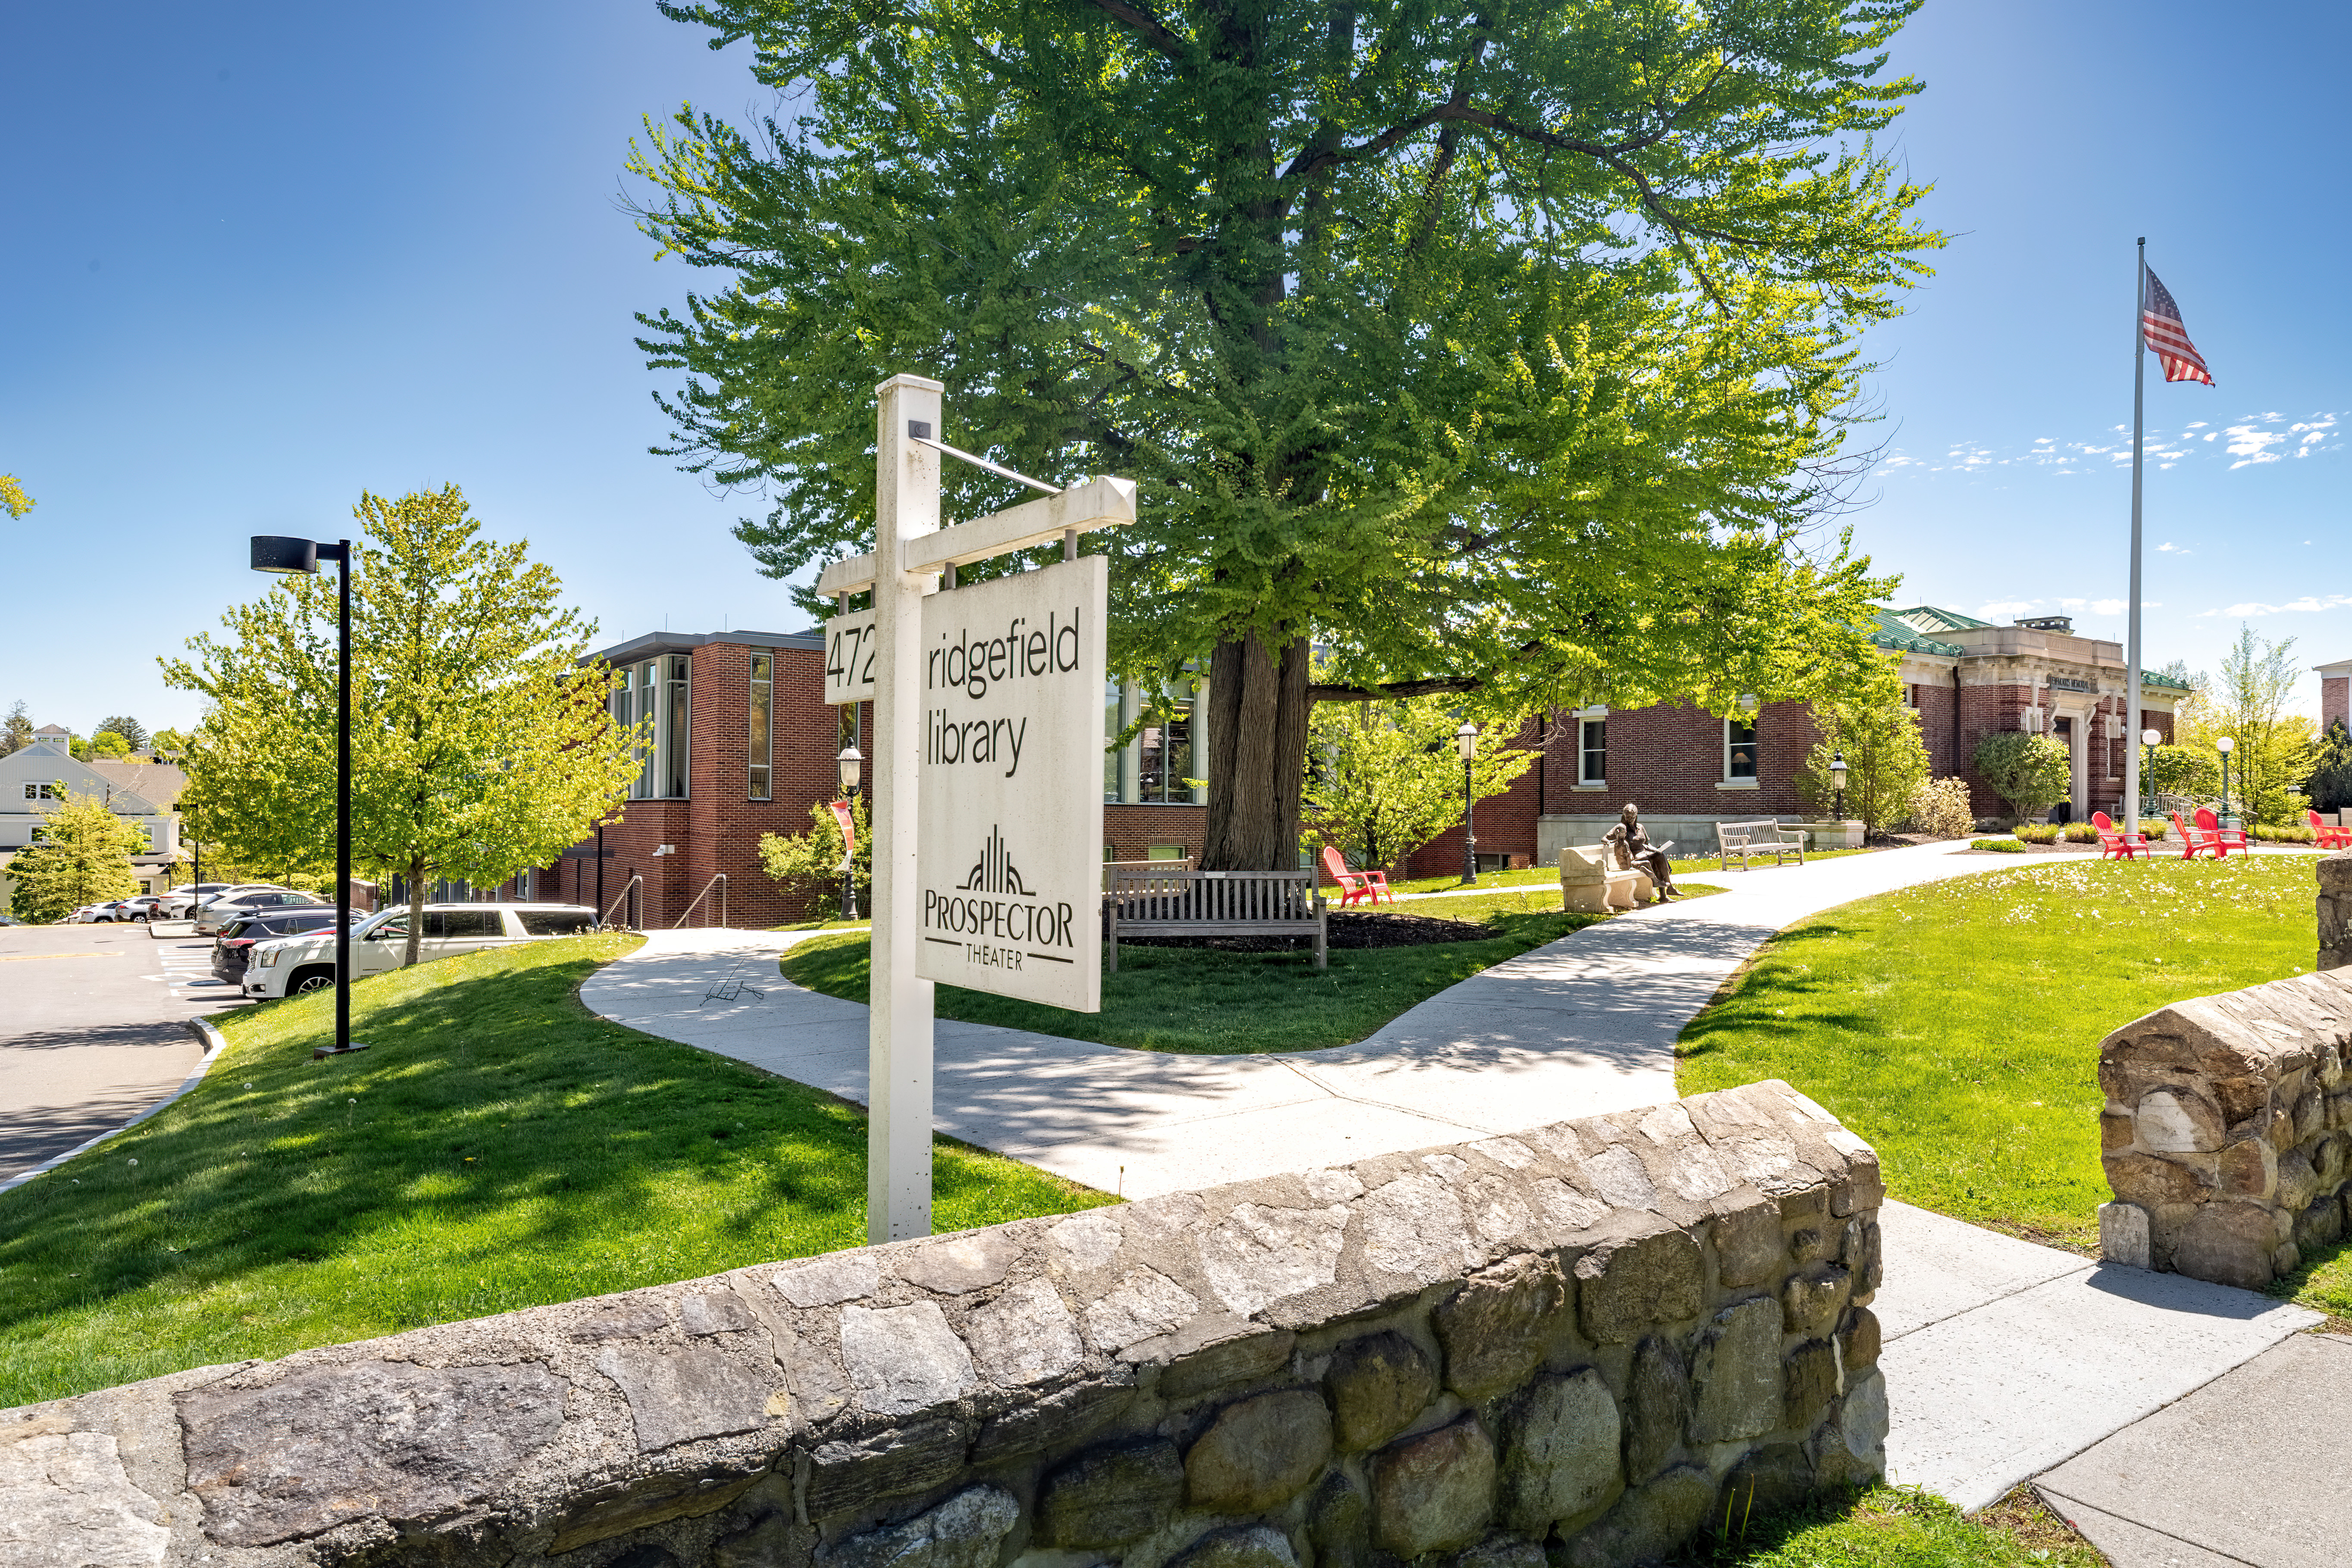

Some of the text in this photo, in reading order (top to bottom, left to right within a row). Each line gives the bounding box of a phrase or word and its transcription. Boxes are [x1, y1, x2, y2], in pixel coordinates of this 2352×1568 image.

[826, 623, 875, 688] 472
[929, 607, 1079, 700] ridgefield
[928, 708, 1027, 778] library
[925, 889, 1073, 948] PROSPECTOR
[966, 943, 1022, 971] THEATER
